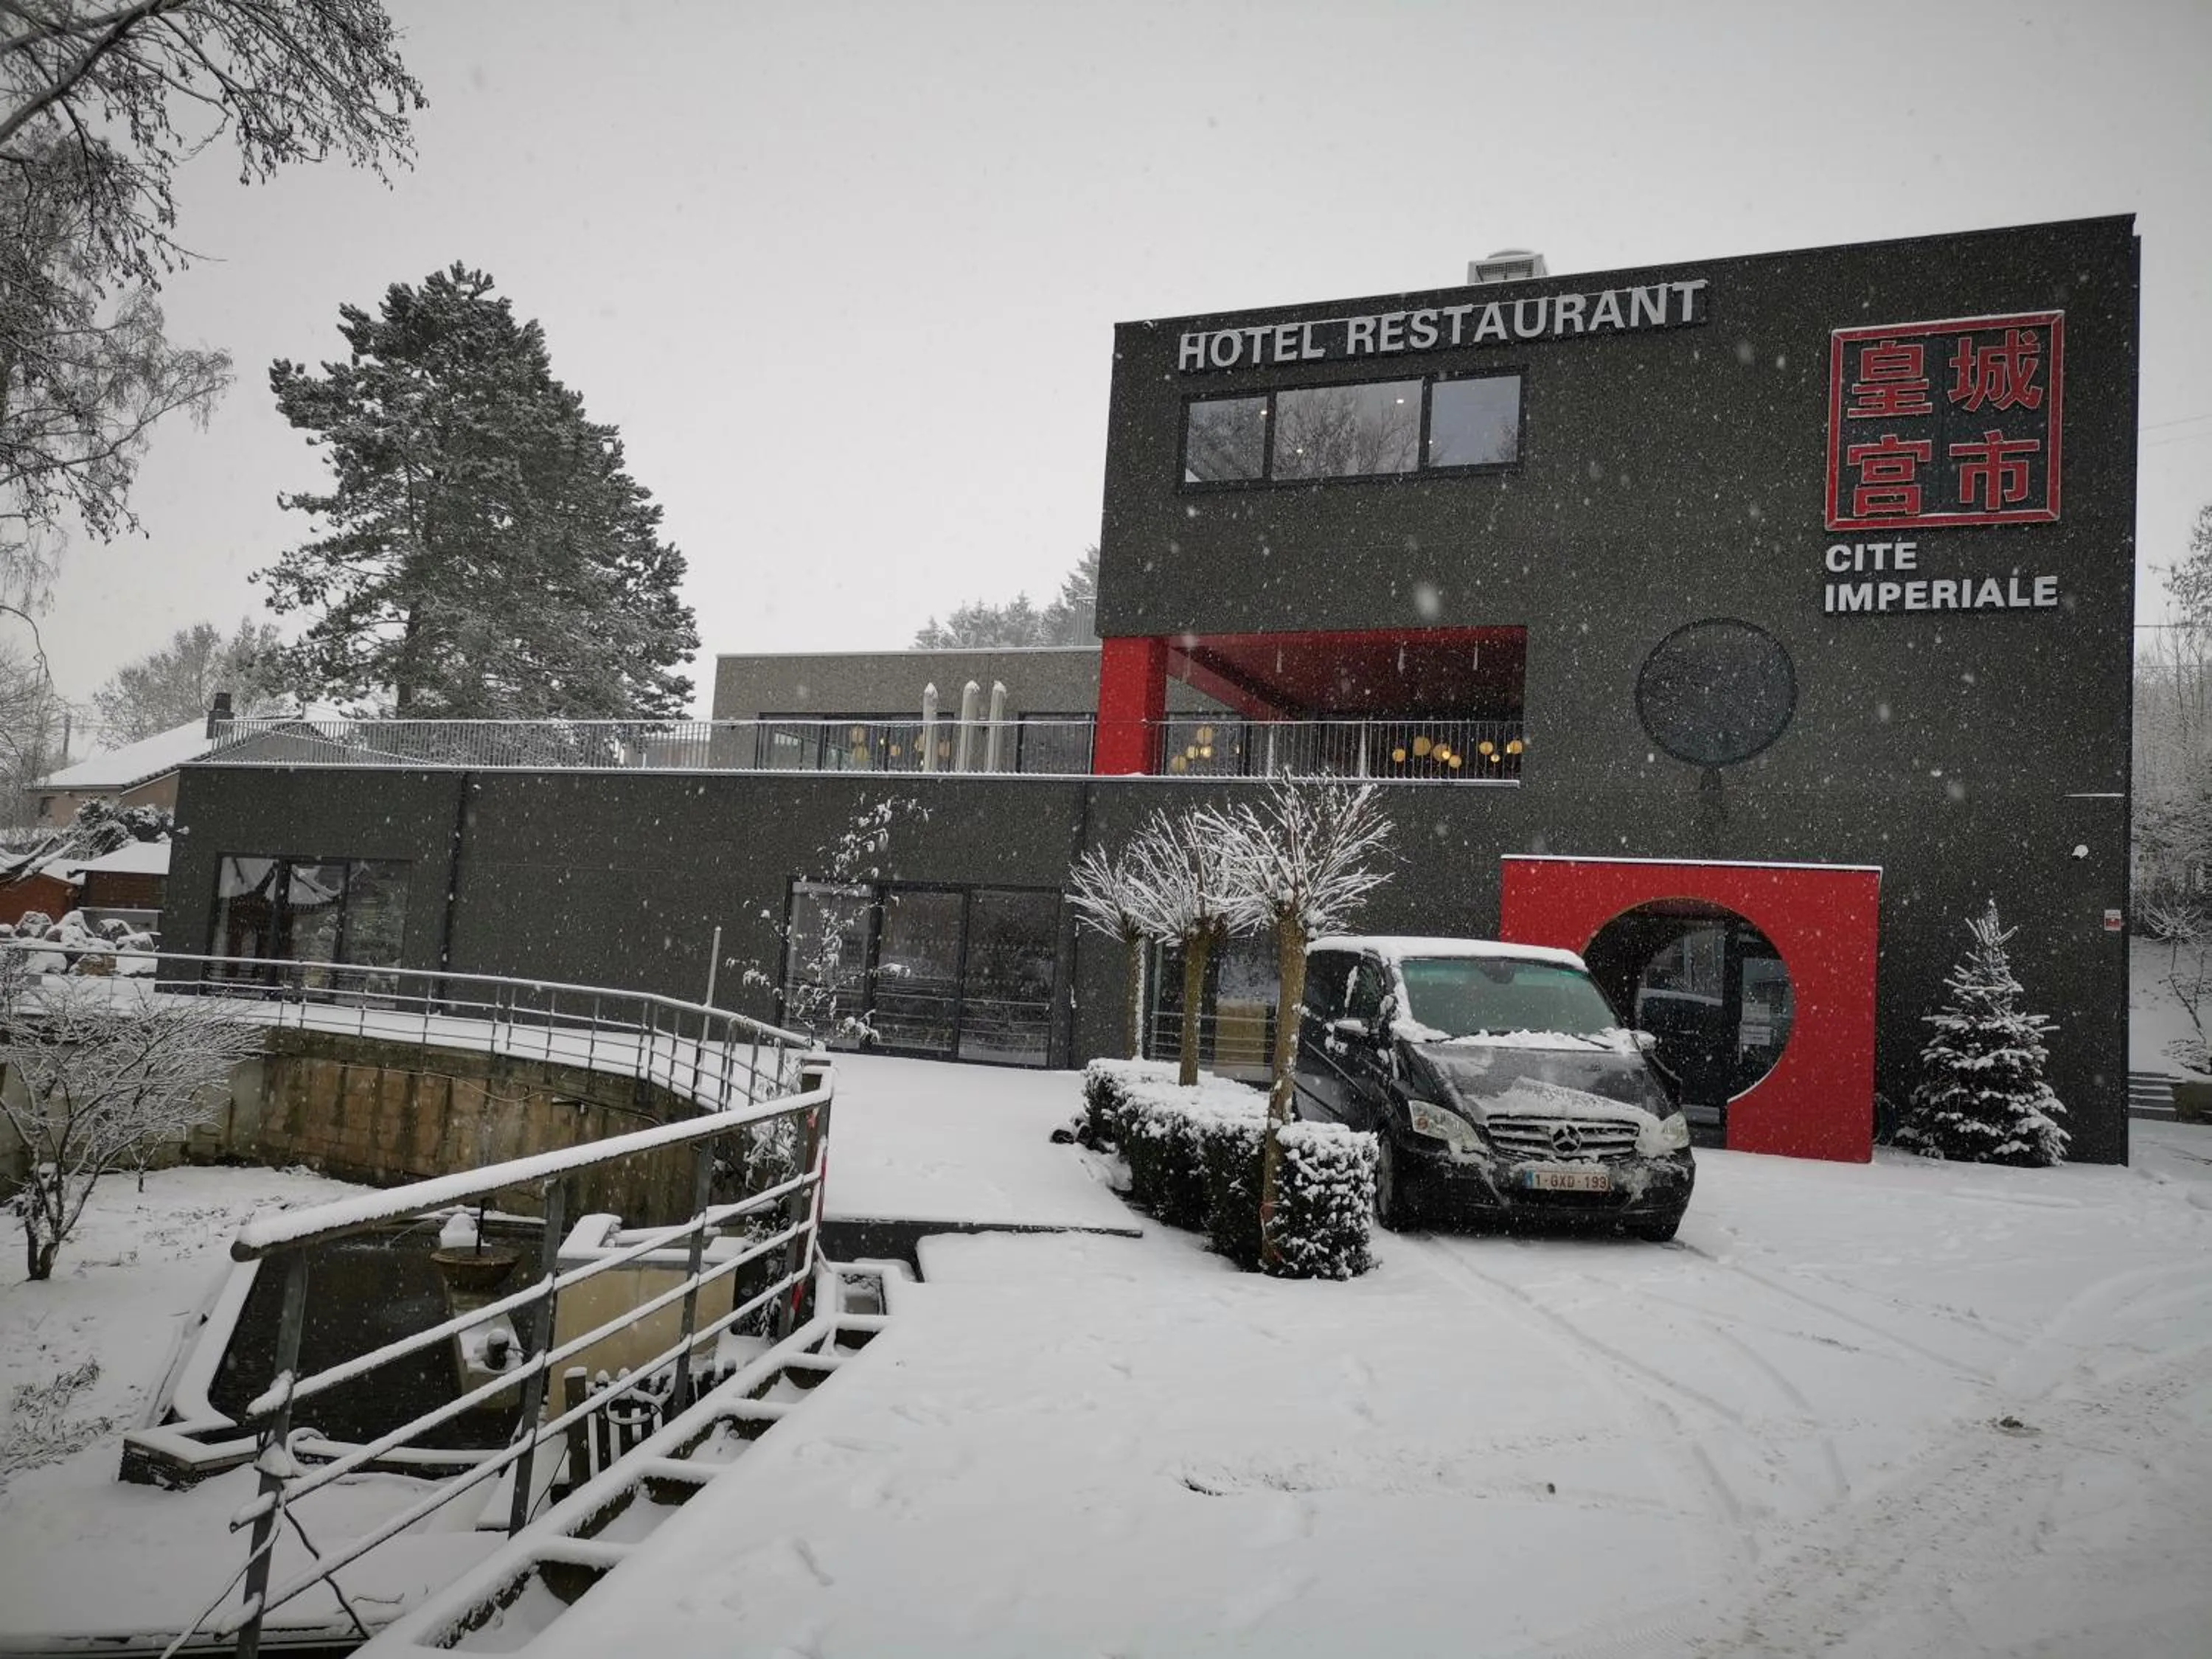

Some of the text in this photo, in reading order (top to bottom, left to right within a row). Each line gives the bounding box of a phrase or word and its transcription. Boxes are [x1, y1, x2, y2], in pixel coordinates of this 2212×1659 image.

[1178, 279, 1707, 370] HOTEL RESTAURANT
[1825, 542, 1917, 572] CITE
[1824, 576, 2059, 613] IMPERIALE
